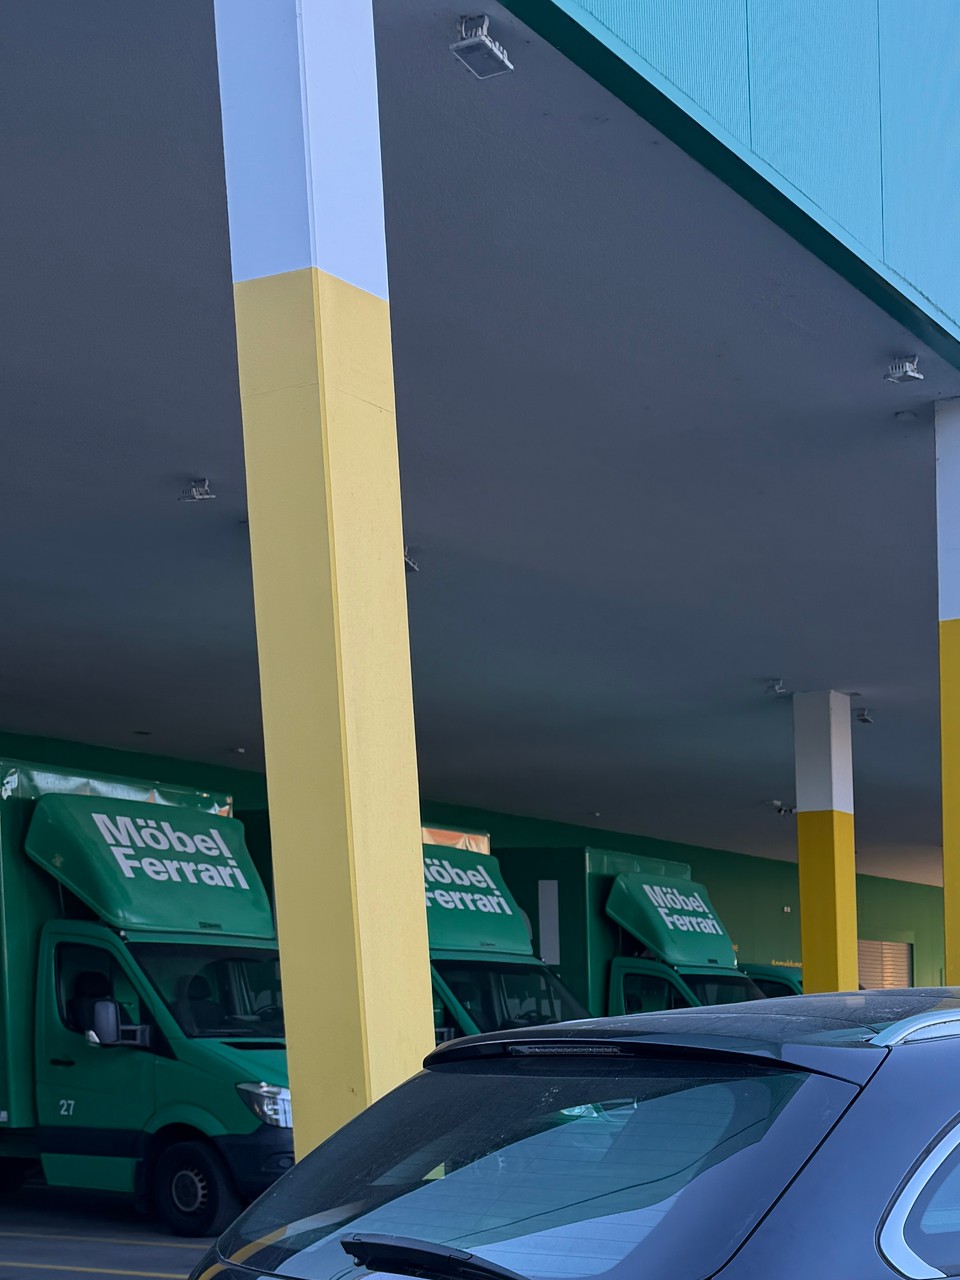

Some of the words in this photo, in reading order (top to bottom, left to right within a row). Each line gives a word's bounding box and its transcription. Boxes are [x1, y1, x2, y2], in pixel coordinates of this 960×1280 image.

[91, 813, 233, 858] Möbel
[110, 846, 250, 890] Ferrari
[424, 858, 497, 889] öbel
[642, 884, 709, 913] Möbel
[657, 907, 723, 935] Ferrari
[60, 1100, 75, 1115] 27
